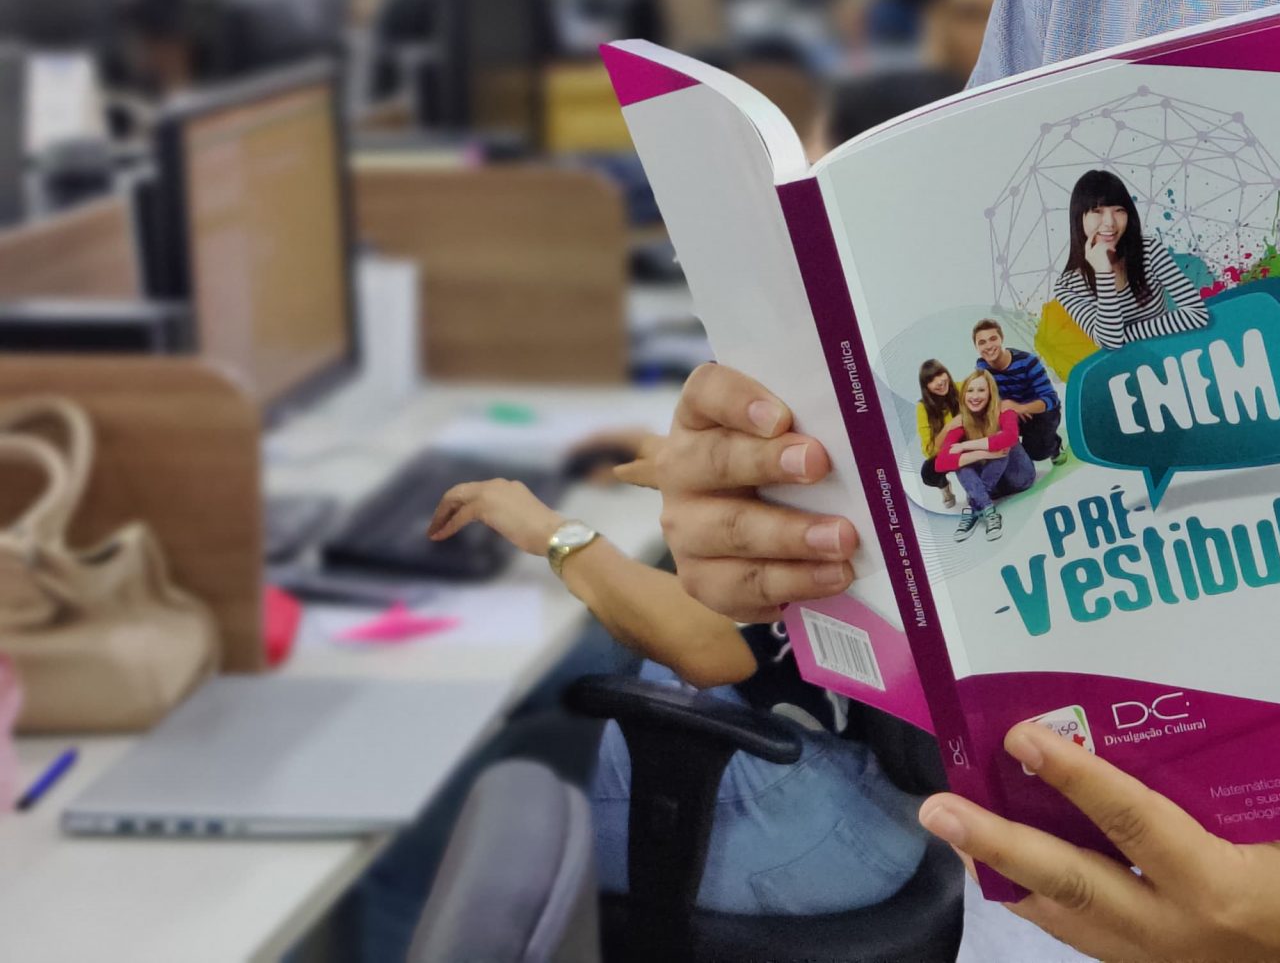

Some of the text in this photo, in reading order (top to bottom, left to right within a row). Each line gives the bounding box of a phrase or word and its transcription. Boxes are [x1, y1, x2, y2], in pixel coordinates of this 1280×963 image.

[840, 340, 869, 413] Matemática
[876, 468, 927, 627] Matemática e suas Tecnologias
[1104, 718, 1207, 746] Divulgação Cultural
[1245, 798, 1253, 807] e
